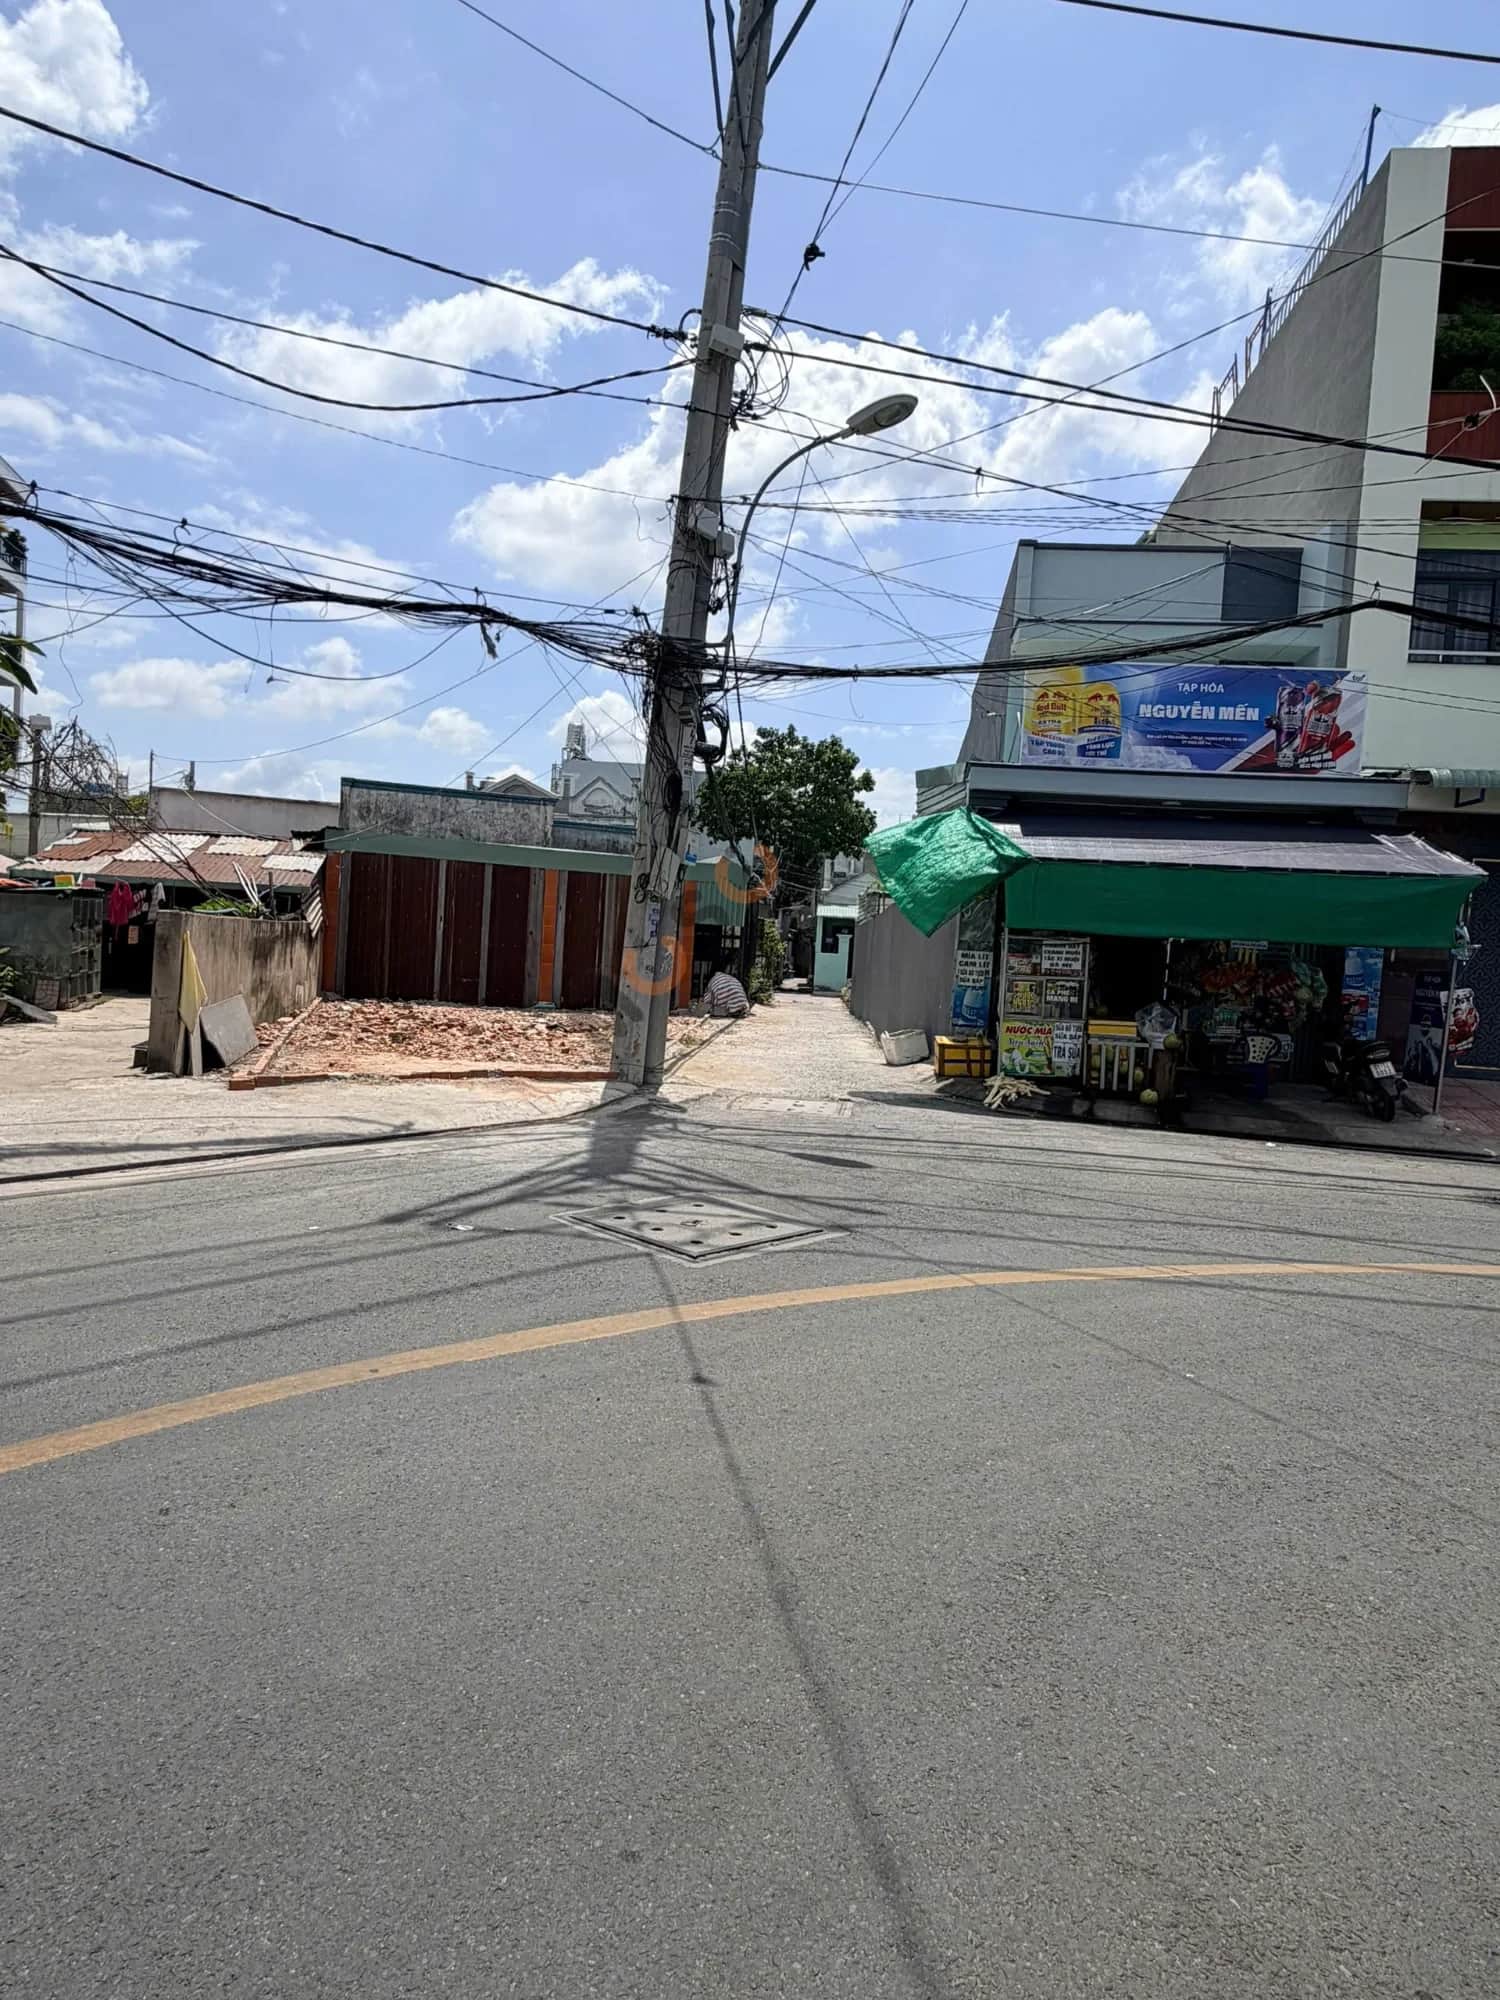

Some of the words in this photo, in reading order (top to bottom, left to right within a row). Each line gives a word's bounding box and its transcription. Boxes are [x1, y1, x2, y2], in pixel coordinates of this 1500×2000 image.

[1177, 682, 1198, 695] TẠP
[1138, 701, 1215, 720] NGUYỄN
[1218, 702, 1260, 721] MẾN
